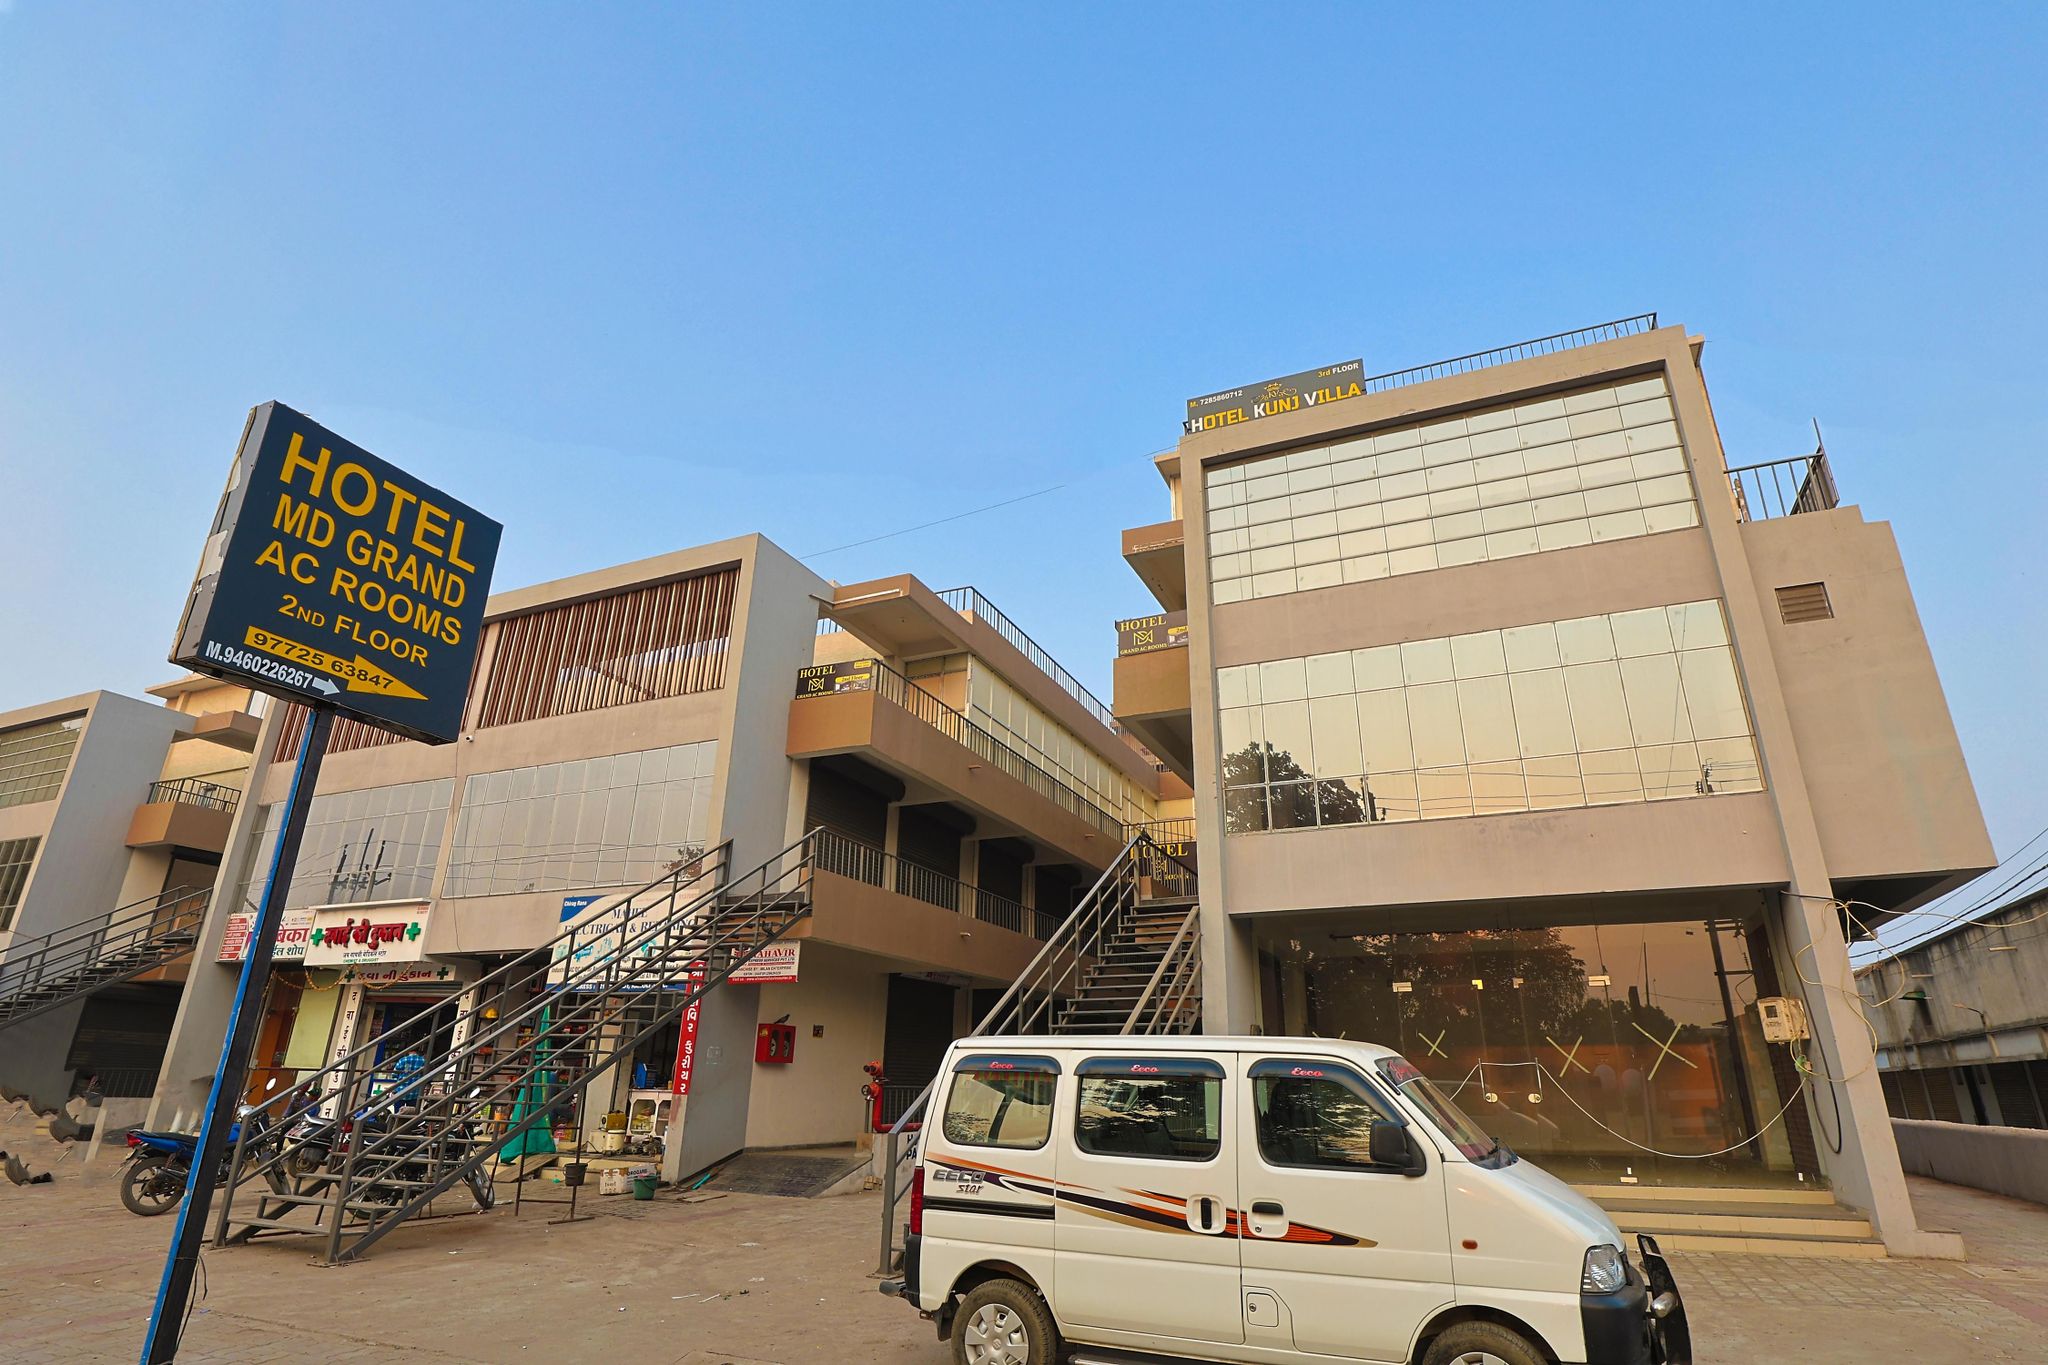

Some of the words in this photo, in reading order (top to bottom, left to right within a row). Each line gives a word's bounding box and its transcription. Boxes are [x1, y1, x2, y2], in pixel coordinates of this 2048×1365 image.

[1318, 369, 1331, 378] 3rd
[1332, 362, 1359, 375] FLOOR
[1191, 407, 1249, 433] HOTEL
[1254, 395, 1300, 419] KUNJ
[1304, 382, 1362, 406] VILLA
[279, 432, 476, 574] HOTEL
[272, 493, 336, 548] MD
[346, 528, 466, 608] GRAND
[255, 540, 321, 585] AC
[330, 567, 461, 646] ROOMS
[279, 594, 326, 628] 2ND
[333, 614, 429, 667] FLOOR
[1120, 616, 1167, 632] HOTEL
[205, 641, 313, 689] M.9460226267
[253, 632, 324, 666] 97725
[331, 660, 394, 689] 63847
[799, 665, 836, 679] HOTEL
[629, 923, 637, 933] &
[367, 923, 407, 950] दुकान
[755, 948, 795, 958] AHAVIR
[383, 969, 397, 980] ની
[1130, 1064, 1159, 1073] Eeco
[1291, 1066, 1323, 1077] Eeco
[933, 1169, 986, 1184] EECO
[956, 1184, 984, 1194] star
